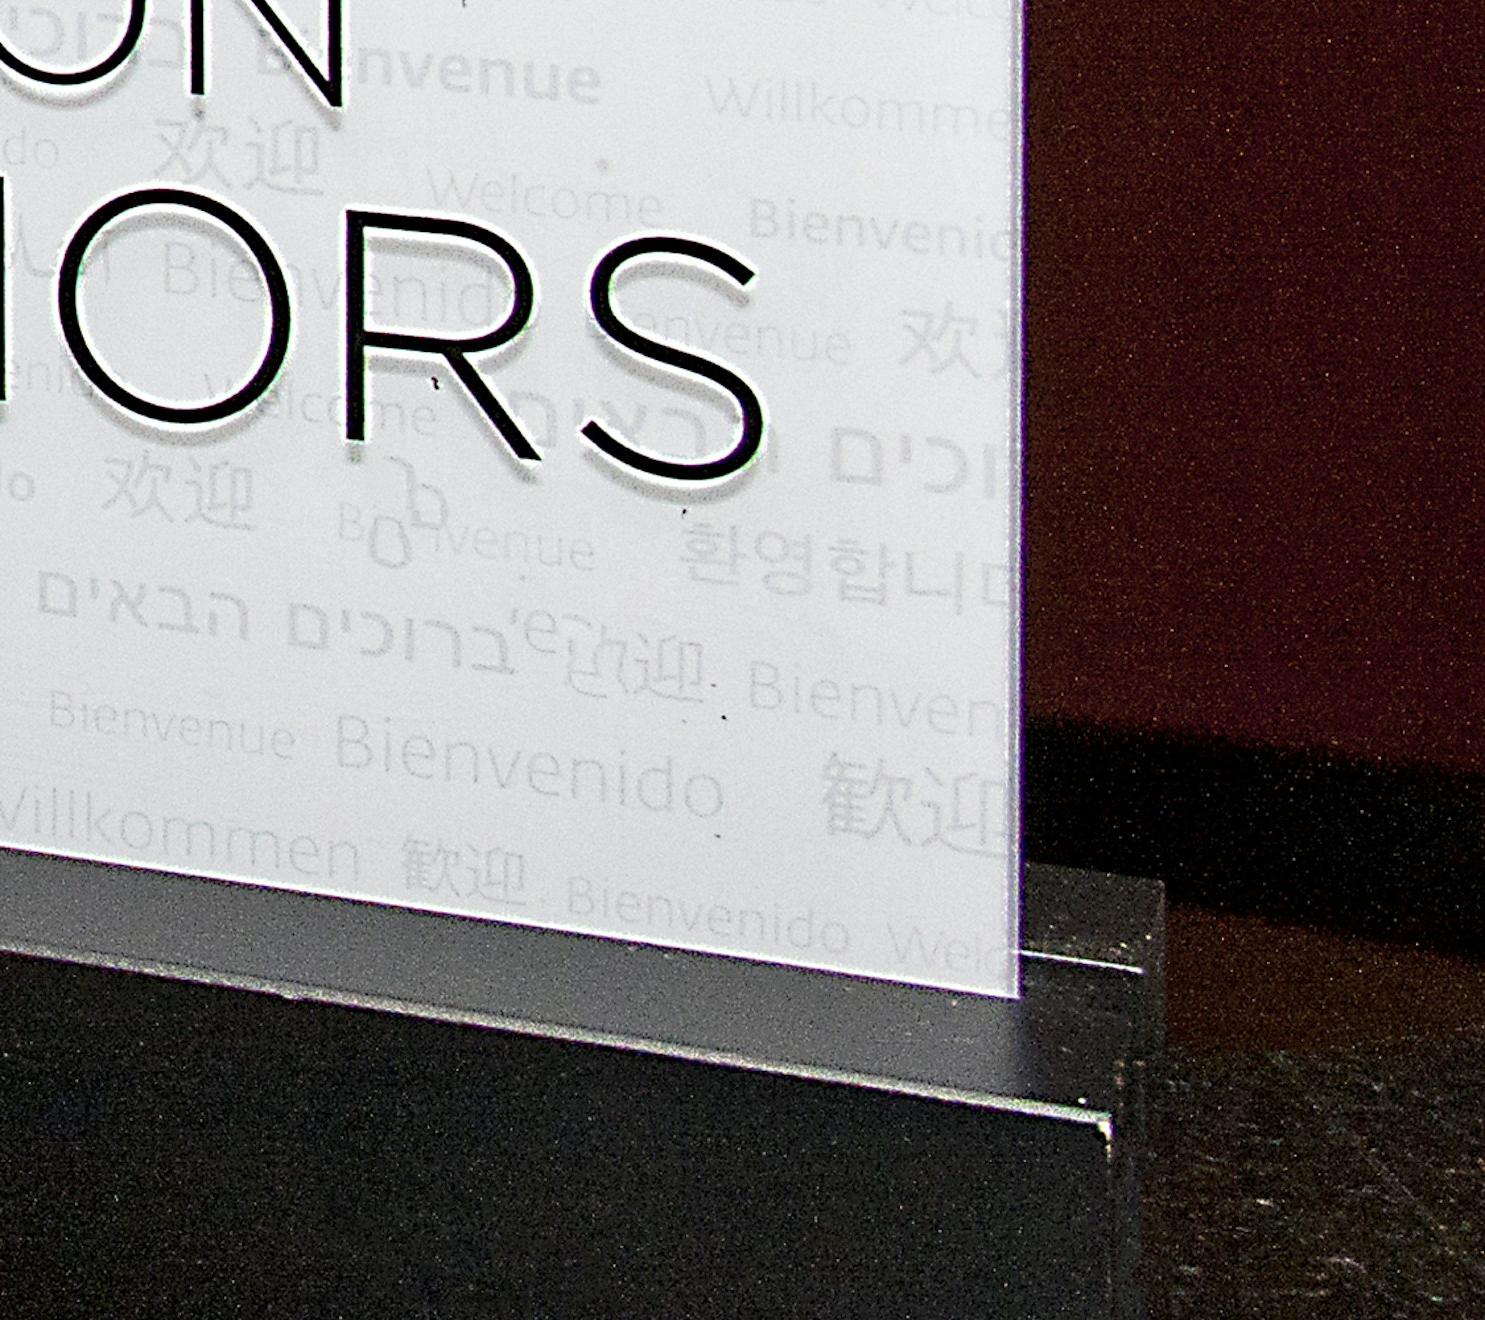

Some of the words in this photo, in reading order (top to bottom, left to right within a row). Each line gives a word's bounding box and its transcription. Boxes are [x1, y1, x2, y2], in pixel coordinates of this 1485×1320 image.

[424, 163, 664, 227] Welcome
[46, 688, 299, 761] Bienvenue
[334, 714, 726, 823] Bienvenido
[565, 874, 853, 956] Bienvenido
